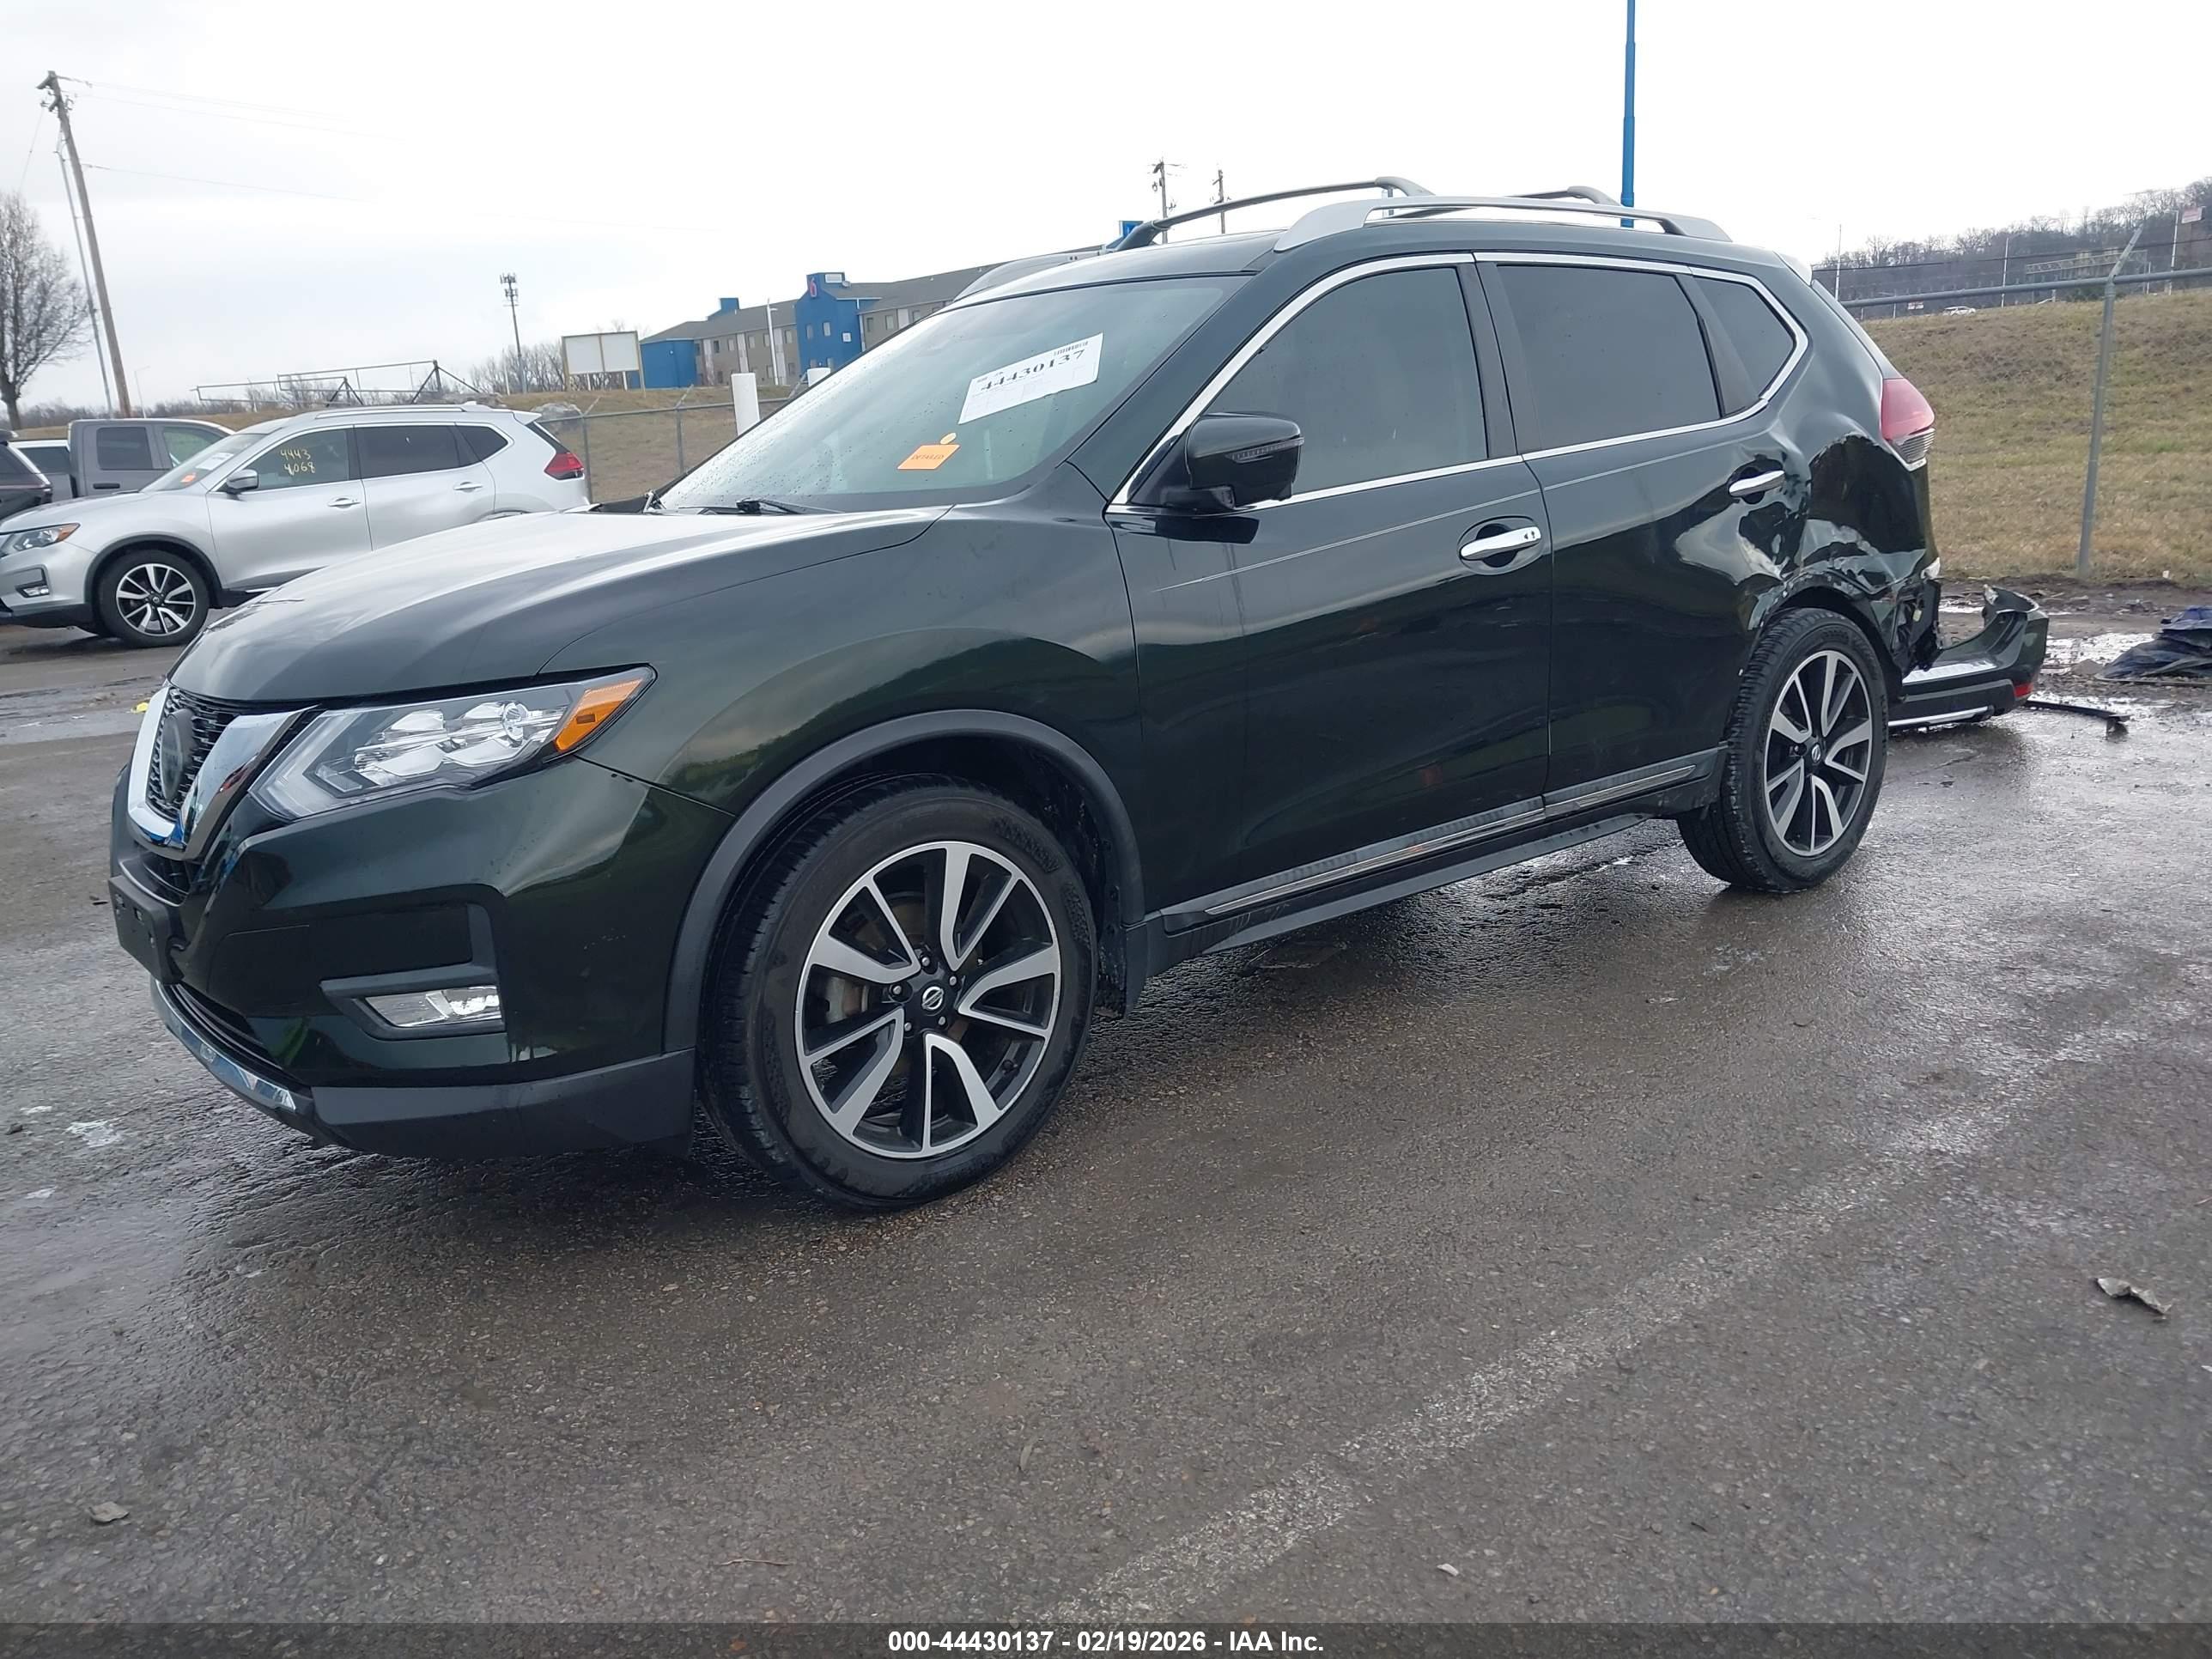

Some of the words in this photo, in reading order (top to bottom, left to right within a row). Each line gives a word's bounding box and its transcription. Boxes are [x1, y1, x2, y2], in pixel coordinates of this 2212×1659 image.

[810, 276, 817, 298] 6
[980, 349, 1085, 391] 44430137
[280, 448, 311, 461] 4443
